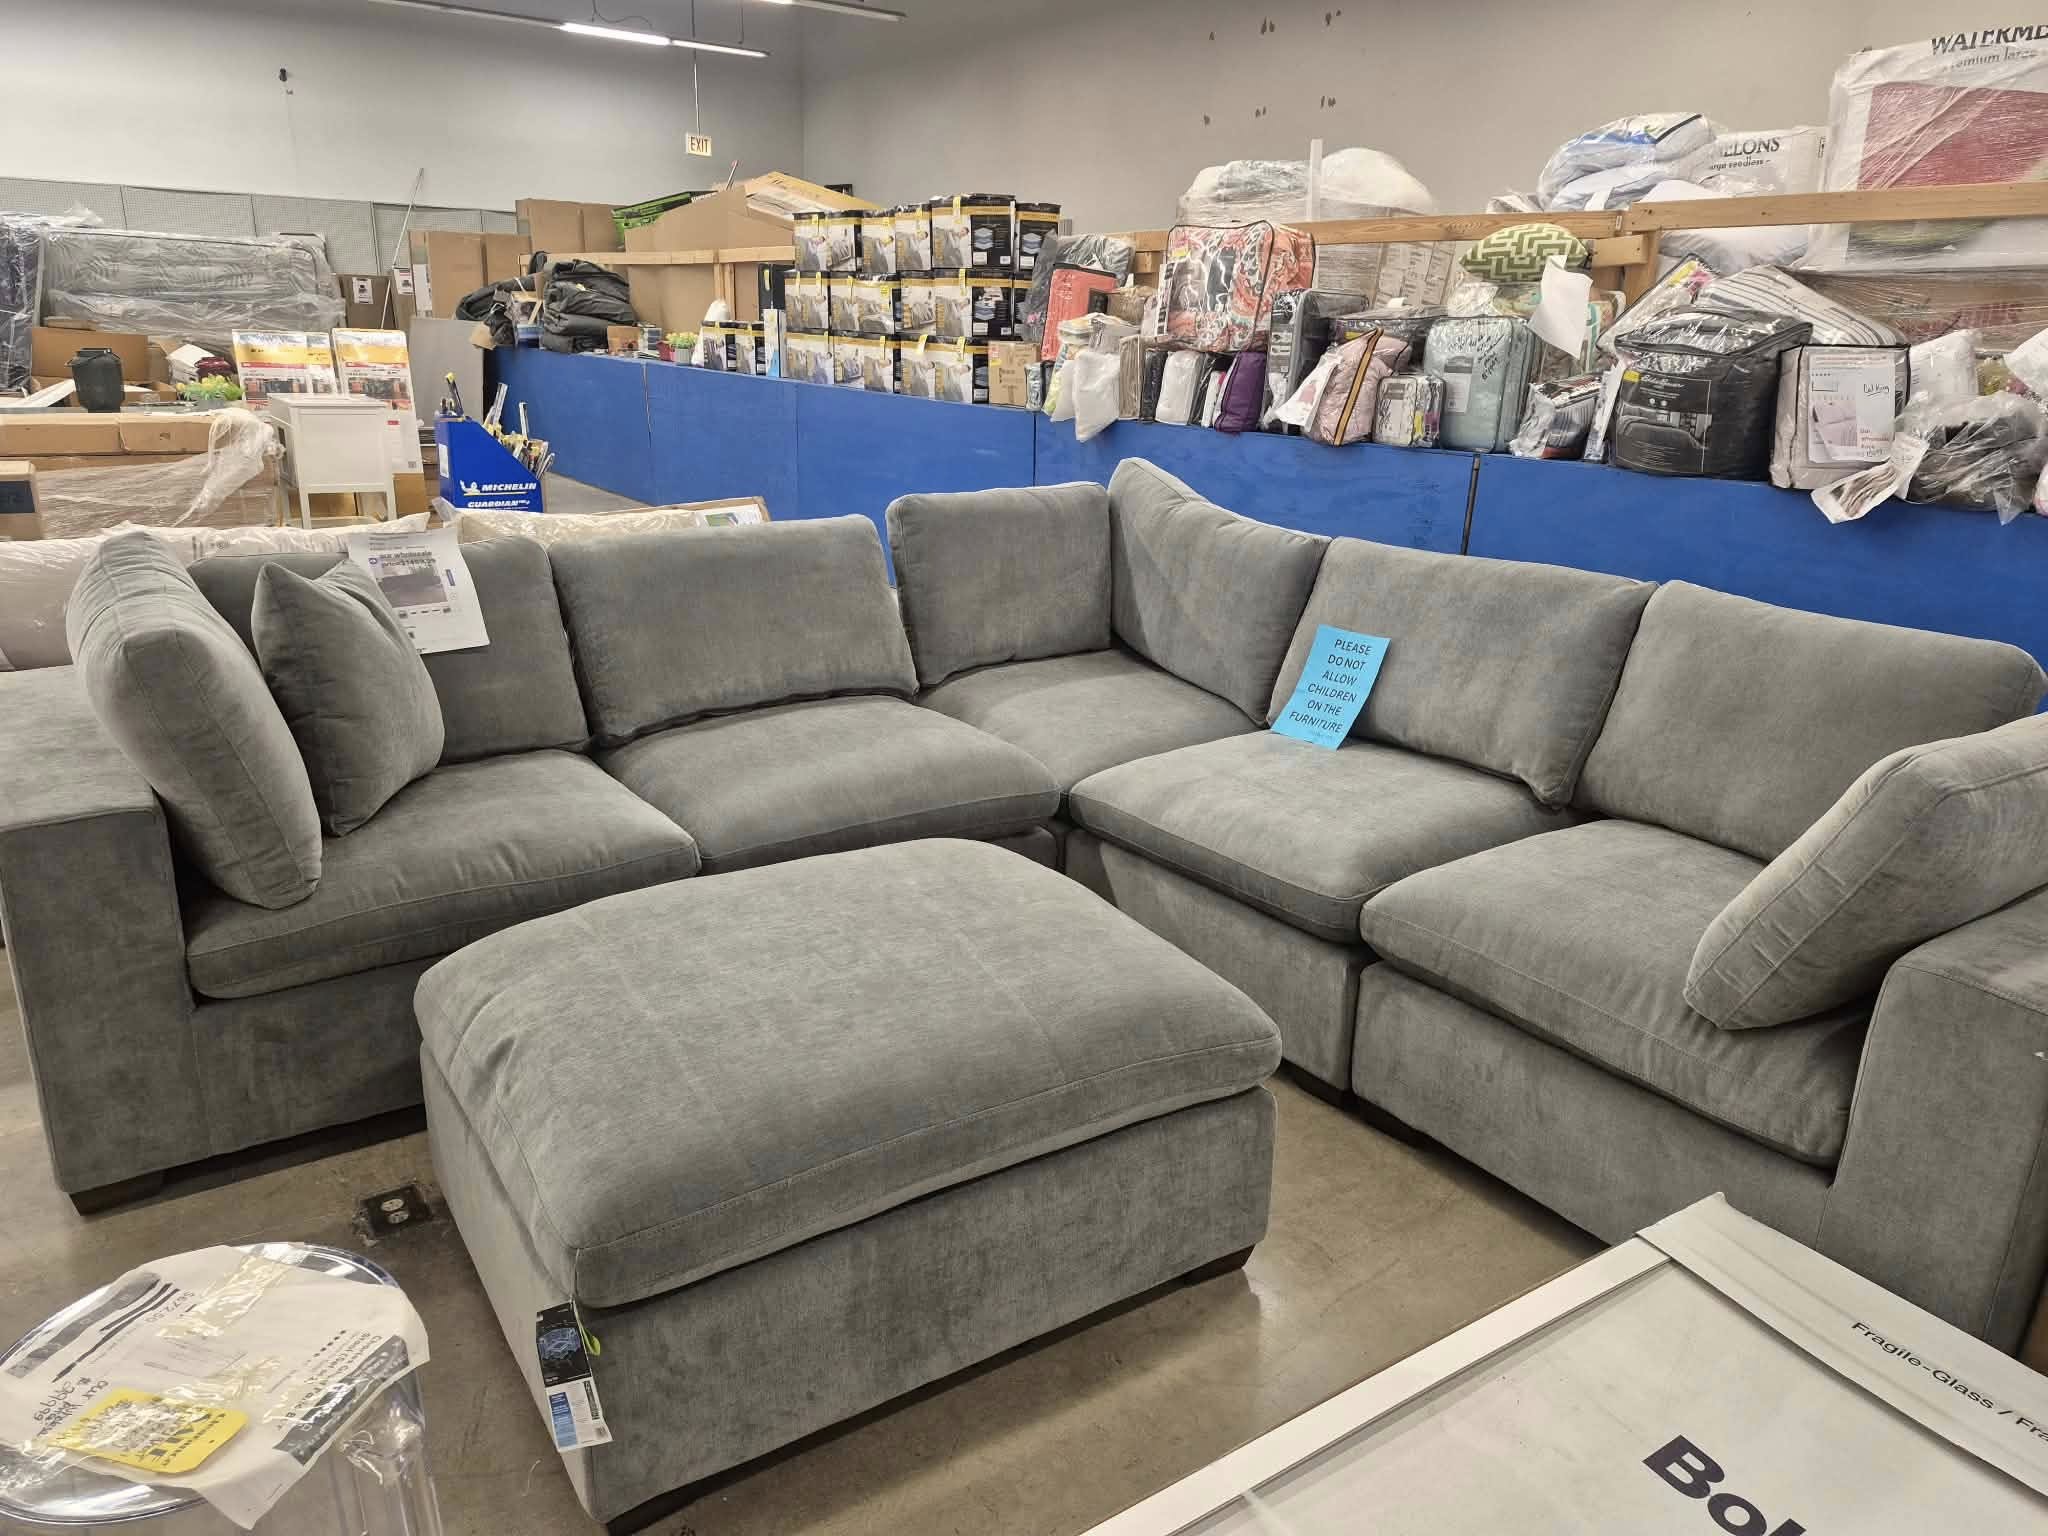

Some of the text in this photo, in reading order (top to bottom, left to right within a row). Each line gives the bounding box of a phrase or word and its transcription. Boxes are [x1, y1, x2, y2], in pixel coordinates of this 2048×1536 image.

[690, 136, 708, 152] EXIT
[481, 482, 537, 492] MICHELIN
[468, 500, 519, 508] GUARDIAN
[1334, 639, 1372, 656] PLEASE
[1327, 654, 1366, 671] DO NOT
[1321, 670, 1358, 686] ALLOW
[1307, 683, 1357, 703] CHILDREN
[1307, 699, 1342, 716] ON THE
[1289, 711, 1344, 733] FURNITURE
[1851, 1321, 1995, 1410] Fragile-Glass
